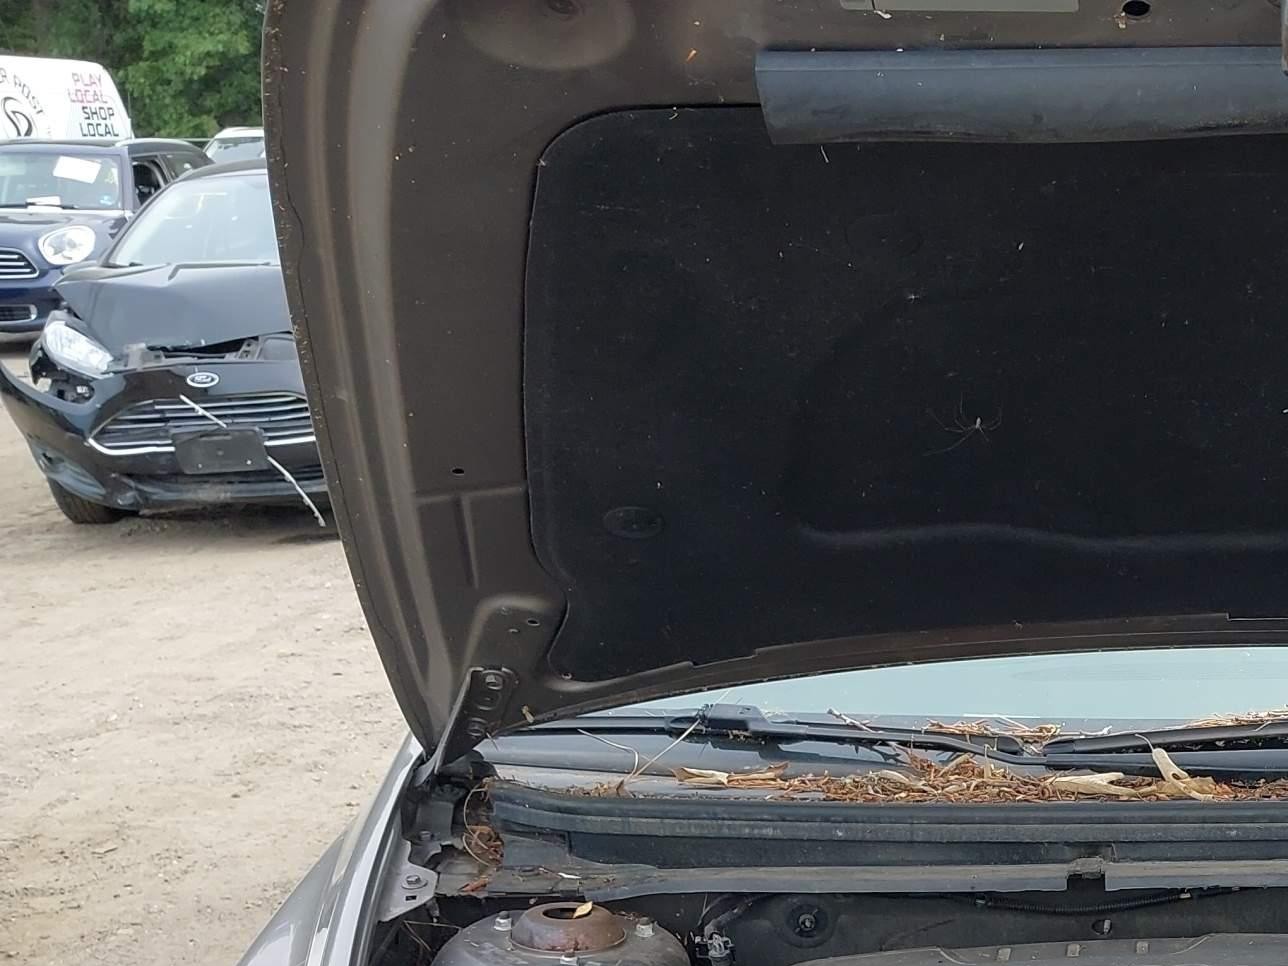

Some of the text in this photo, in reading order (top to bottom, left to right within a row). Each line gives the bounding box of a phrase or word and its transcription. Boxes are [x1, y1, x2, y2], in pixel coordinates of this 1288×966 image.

[72, 72, 102, 87] PLAY
[67, 88, 109, 104] LOCAL
[82, 106, 115, 120] SHOP
[80, 122, 120, 137] LOCAL
